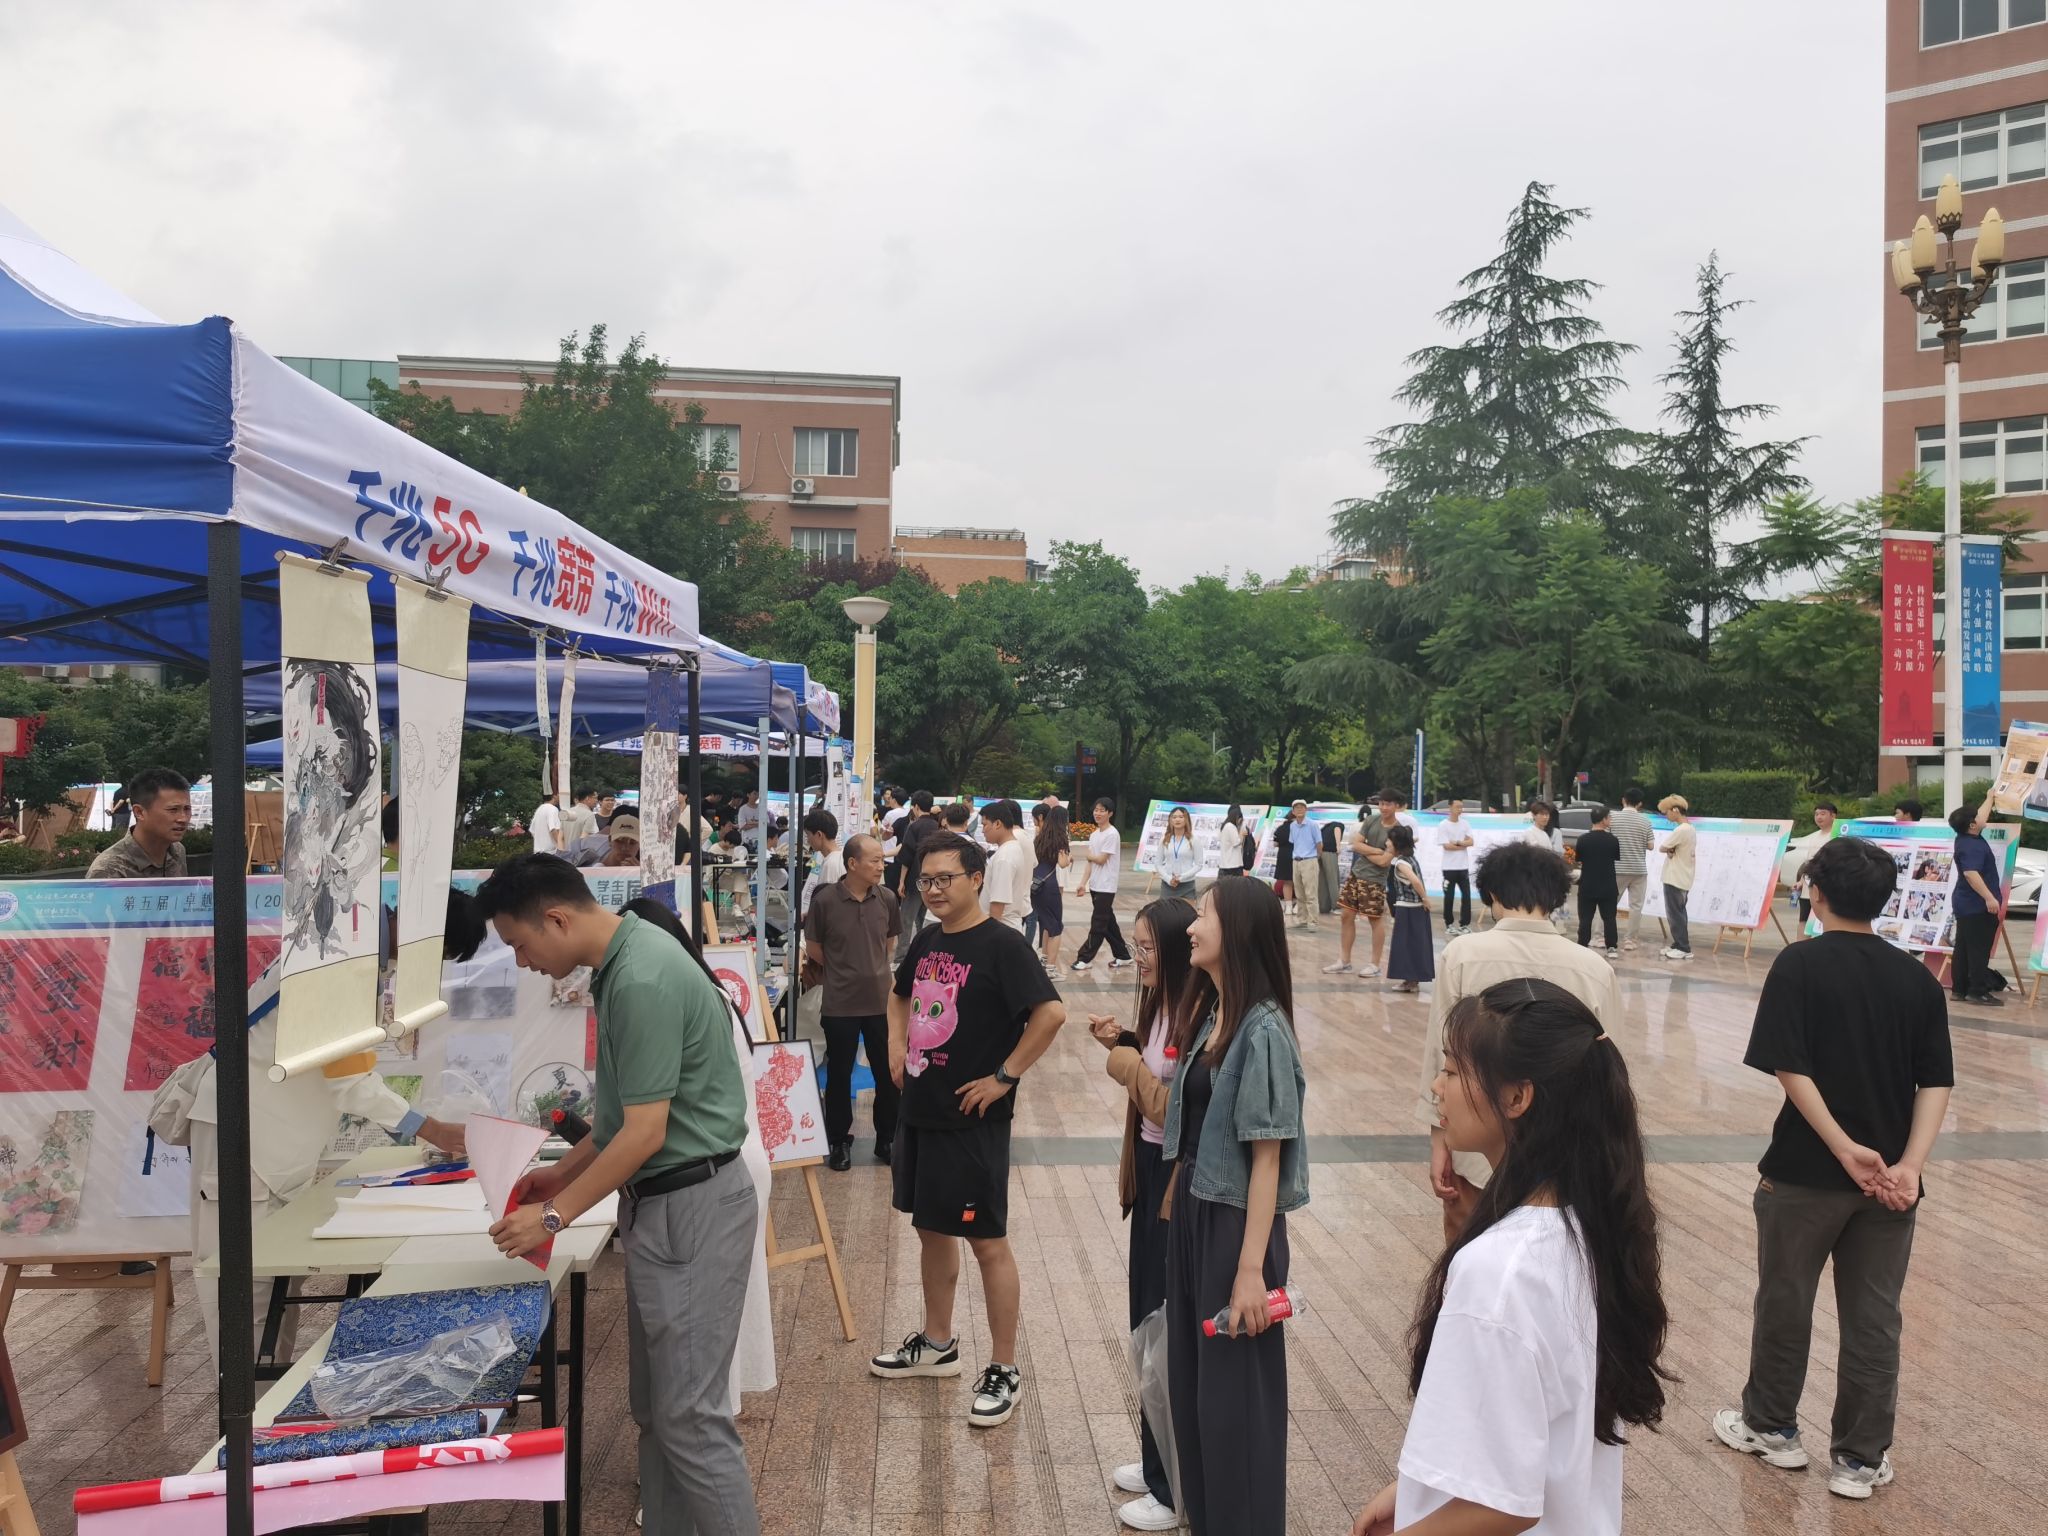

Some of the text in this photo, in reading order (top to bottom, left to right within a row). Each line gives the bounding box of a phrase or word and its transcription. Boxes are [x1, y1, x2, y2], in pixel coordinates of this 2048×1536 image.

[347, 469, 490, 575] 千兆5G
[508, 530, 597, 616] 千兆宽带
[1893, 584, 1902, 672] 创新是第一动力
[1905, 584, 1914, 672] 人才是第一资源
[1917, 585, 1925, 672] 科技是第一生产力
[1973, 587, 1982, 673] 人才强国战略
[1984, 587, 1993, 673] 实施科教兴国战略
[123, 895, 169, 911] 第五届
[597, 880, 625, 893] 学生
[597, 893, 624, 906] 作品
[551, 1065, 575, 1091] 夏
